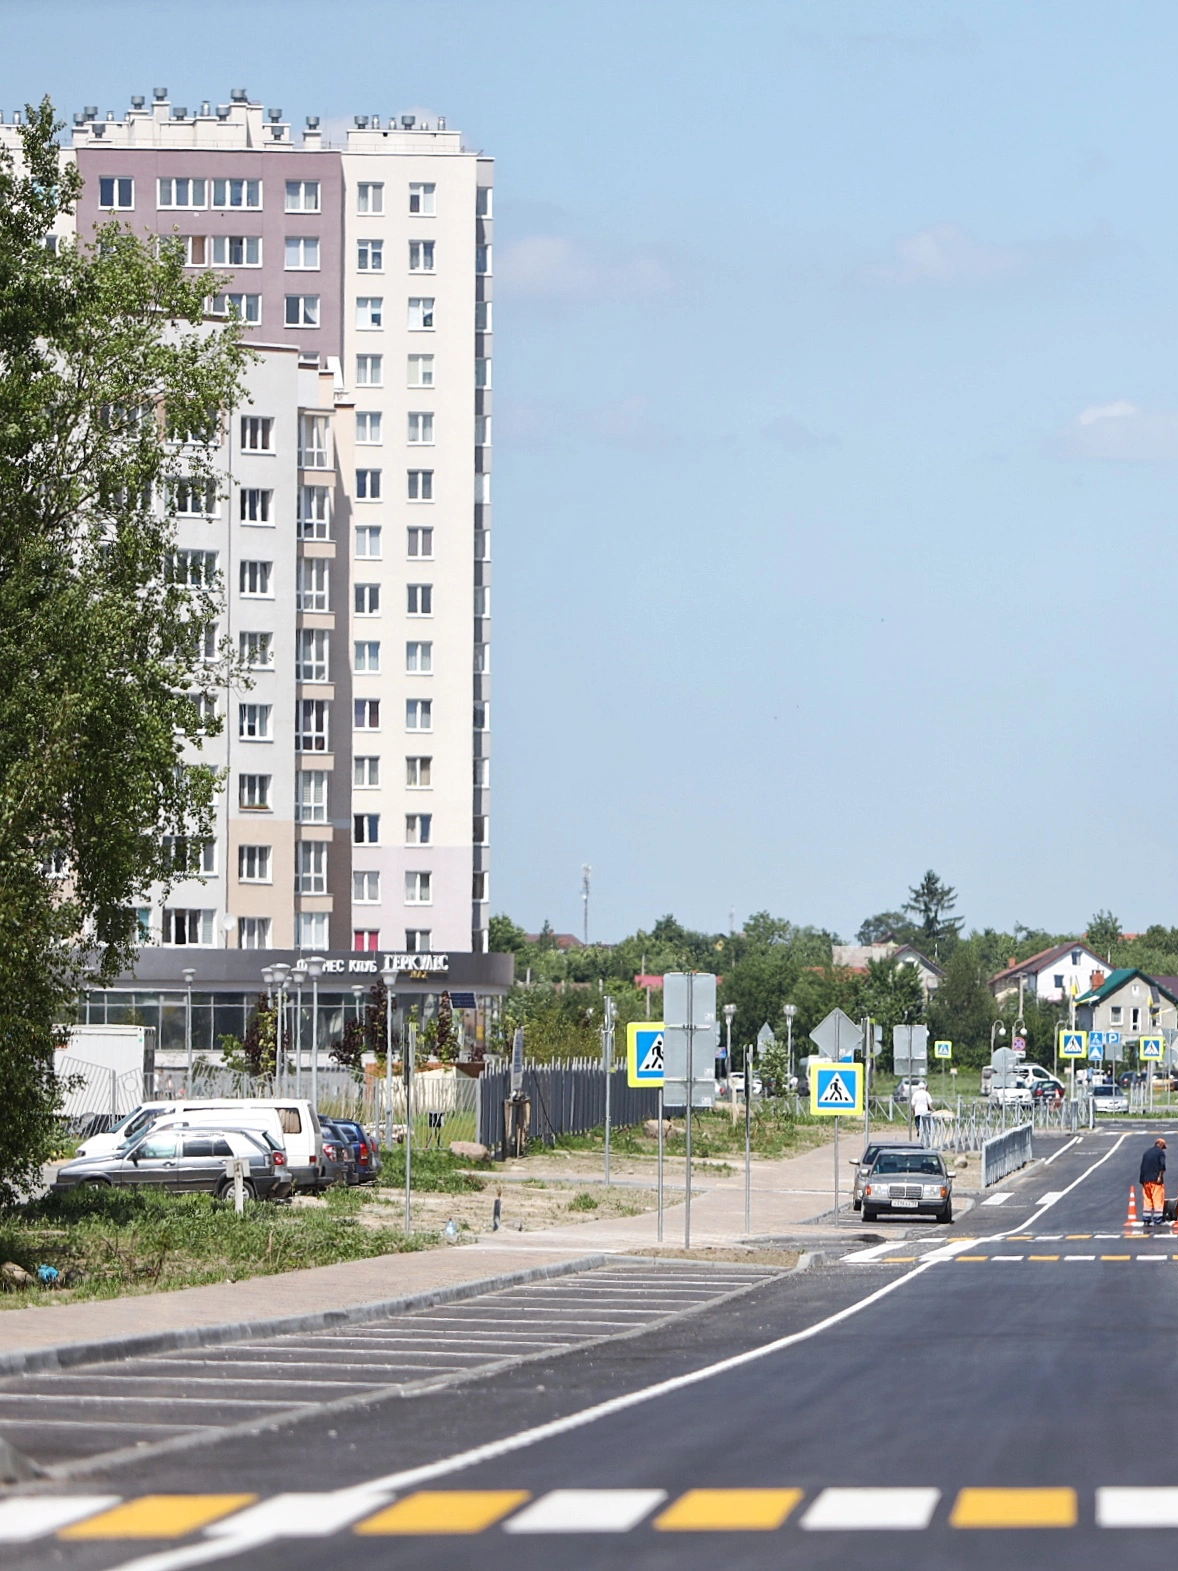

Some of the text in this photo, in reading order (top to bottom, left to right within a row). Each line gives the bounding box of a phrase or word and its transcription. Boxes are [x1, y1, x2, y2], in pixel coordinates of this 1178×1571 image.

[297, 954, 448, 972] ФНЕС КЛУБ ГЕРКУЛЕС
